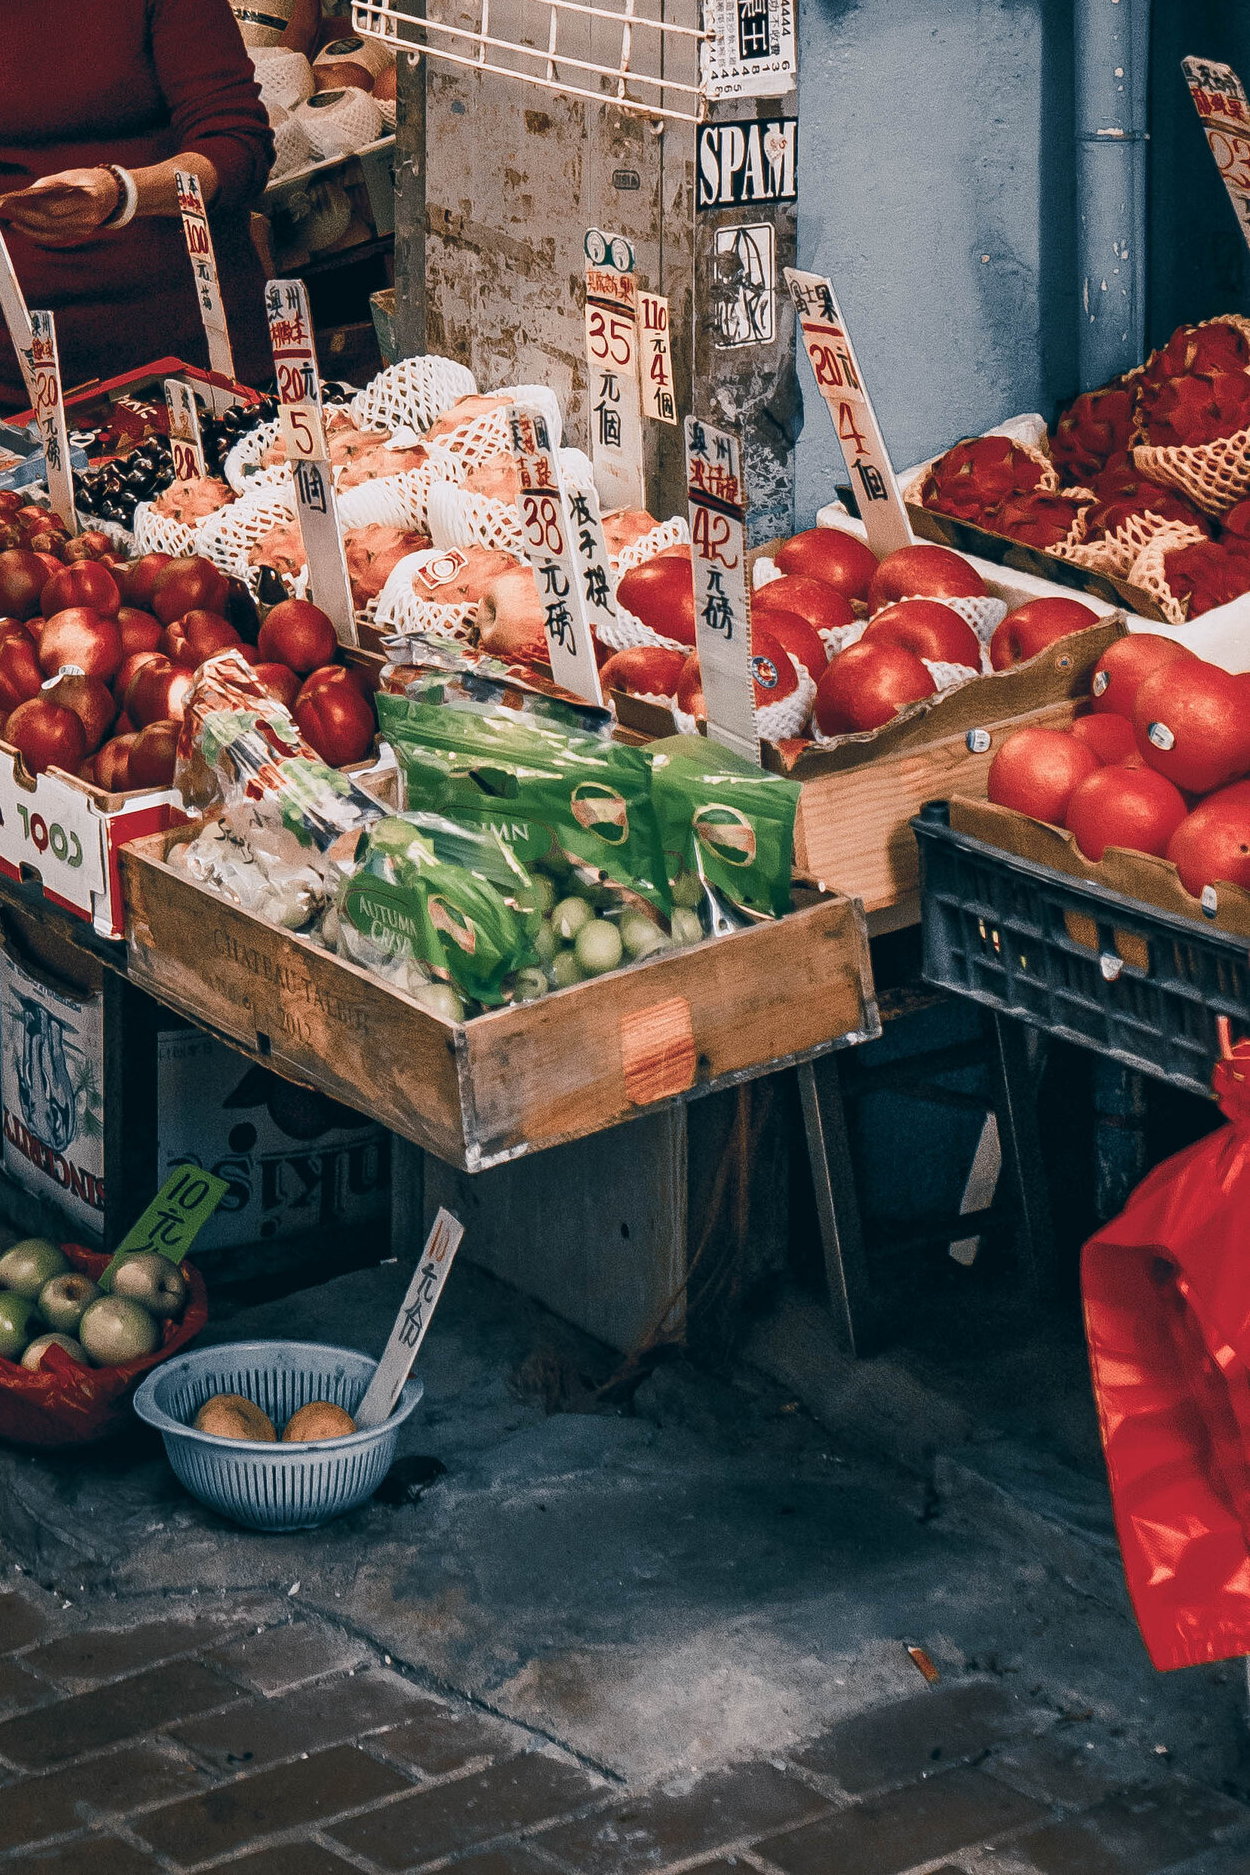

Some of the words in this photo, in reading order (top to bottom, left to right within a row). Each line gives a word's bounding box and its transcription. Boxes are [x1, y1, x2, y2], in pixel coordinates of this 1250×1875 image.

[710, 59, 791, 80] 63184444
[175, 171, 198, 195] 日本
[699, 120, 797, 206] SPAM
[184, 219, 210, 256] 100
[640, 297, 668, 332] 110
[790, 278, 839, 324] 富士果
[588, 311, 633, 366] 35
[650, 331, 667, 355] 元
[37, 371, 60, 408] 20
[650, 355, 669, 387] 4
[654, 387, 673, 420] 個
[290, 411, 315, 456] 5
[838, 401, 871, 456] 4
[851, 456, 890, 503] 個
[523, 495, 565, 558] 38
[692, 506, 740, 571] 42
[358, 895, 418, 942] AUTUMN
[166, 1170, 214, 1213] 10
[148, 1205, 189, 1250] 元
